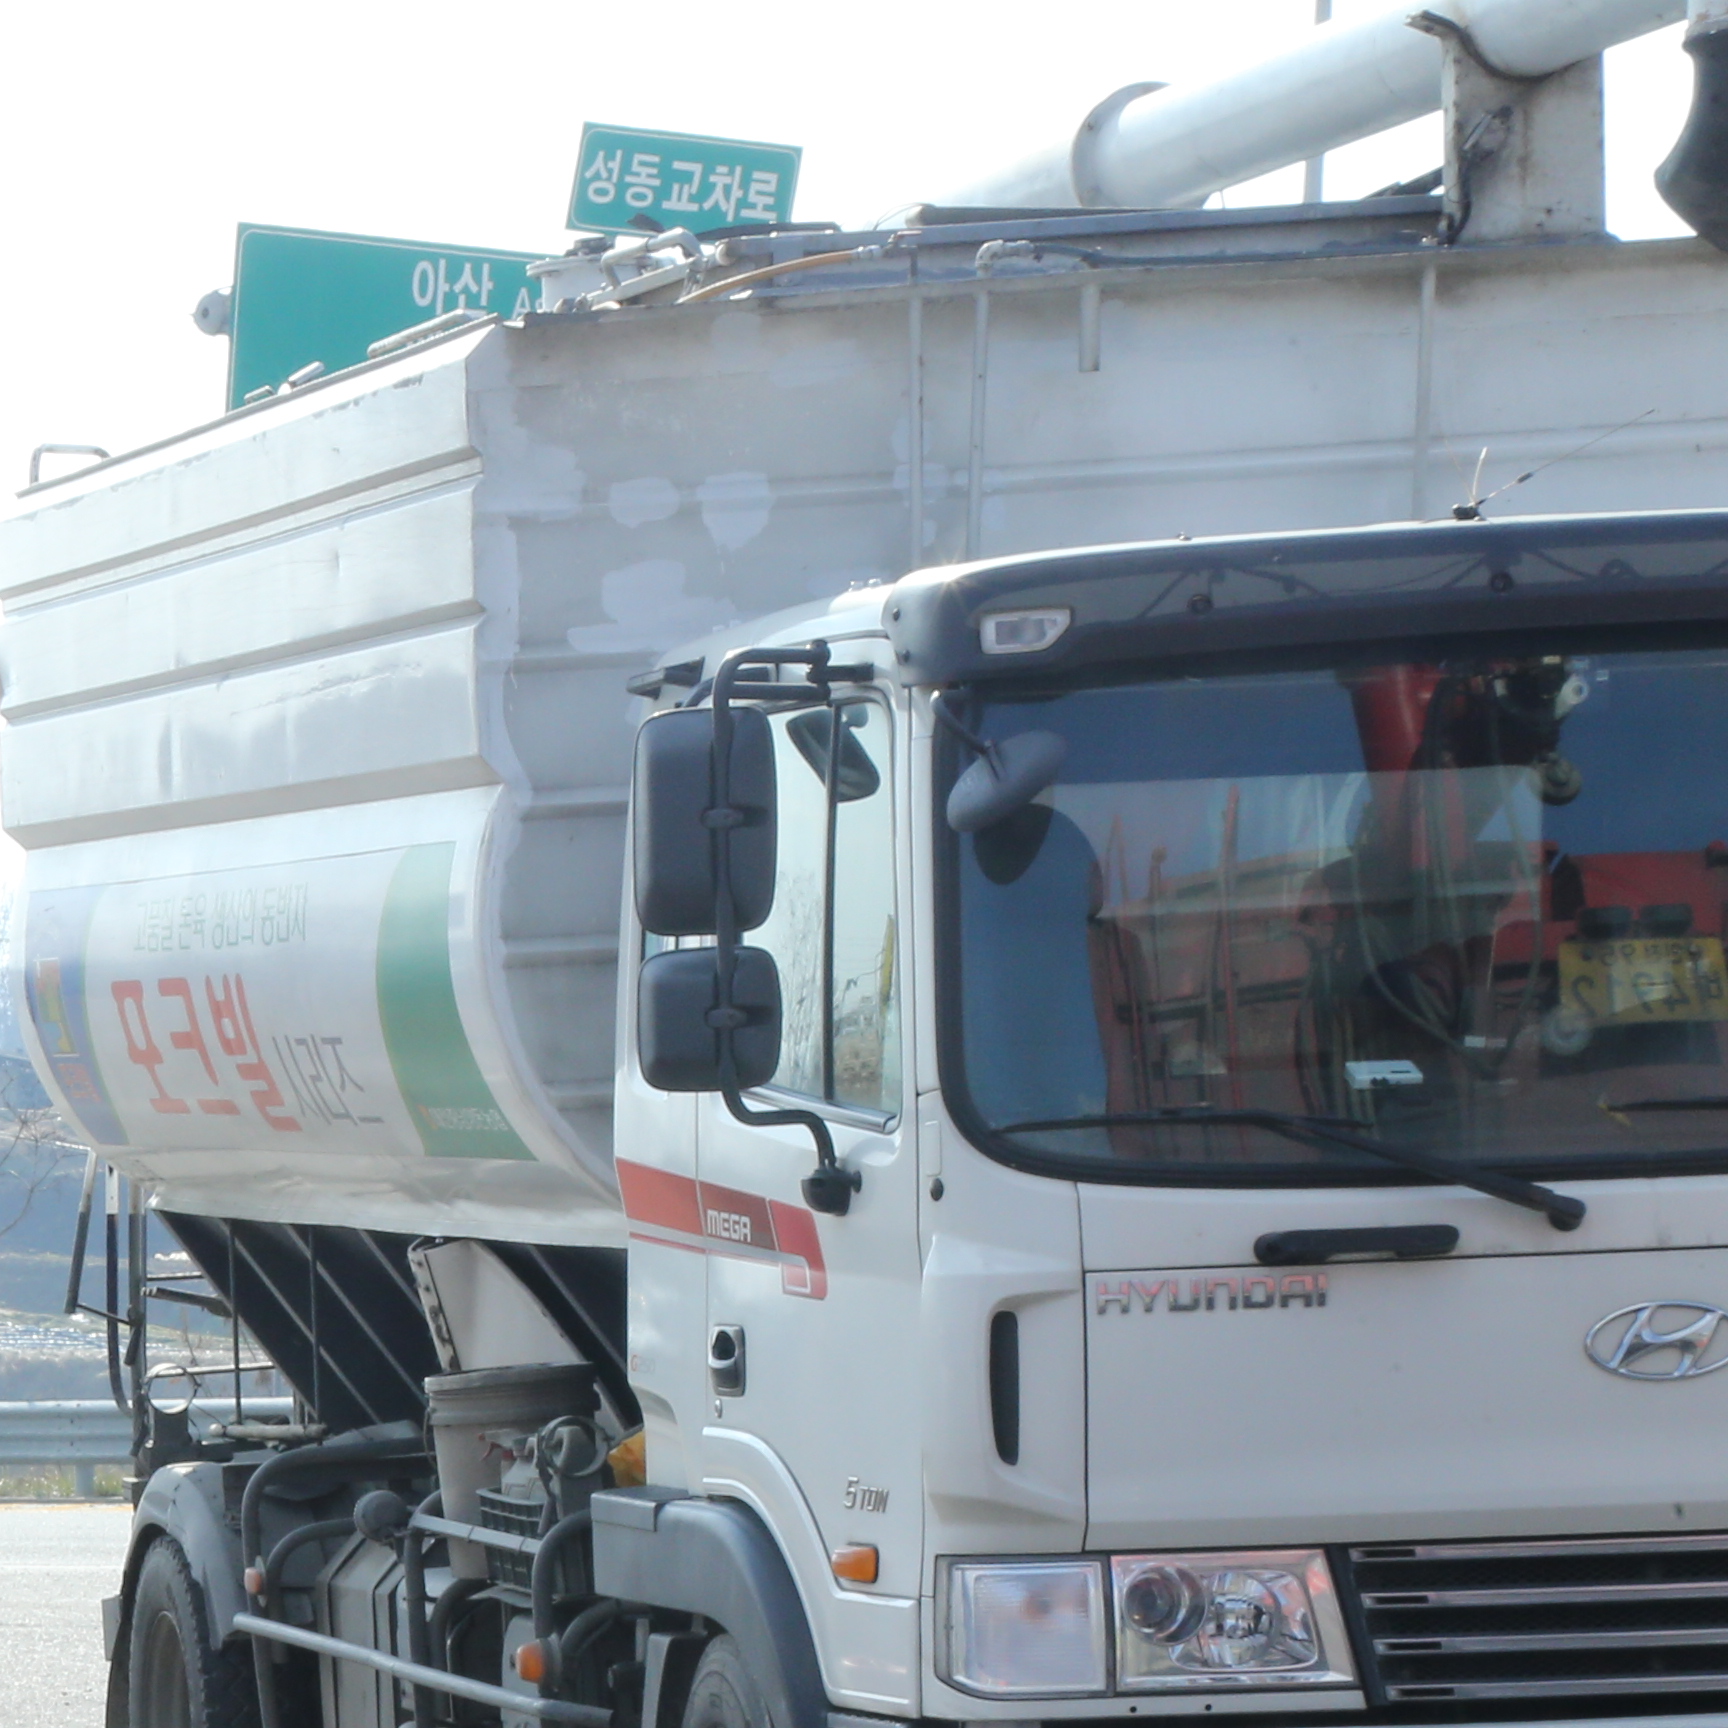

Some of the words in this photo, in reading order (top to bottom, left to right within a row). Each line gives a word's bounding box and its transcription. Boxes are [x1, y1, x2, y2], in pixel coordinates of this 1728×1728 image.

[584, 149, 780, 223] 성동교차로
[411, 257, 494, 317] 아산
[271, 1032, 386, 1127] 시리즈
[707, 1209, 752, 1243] MEGA
[1095, 1272, 1329, 1316] HYUNDAI
